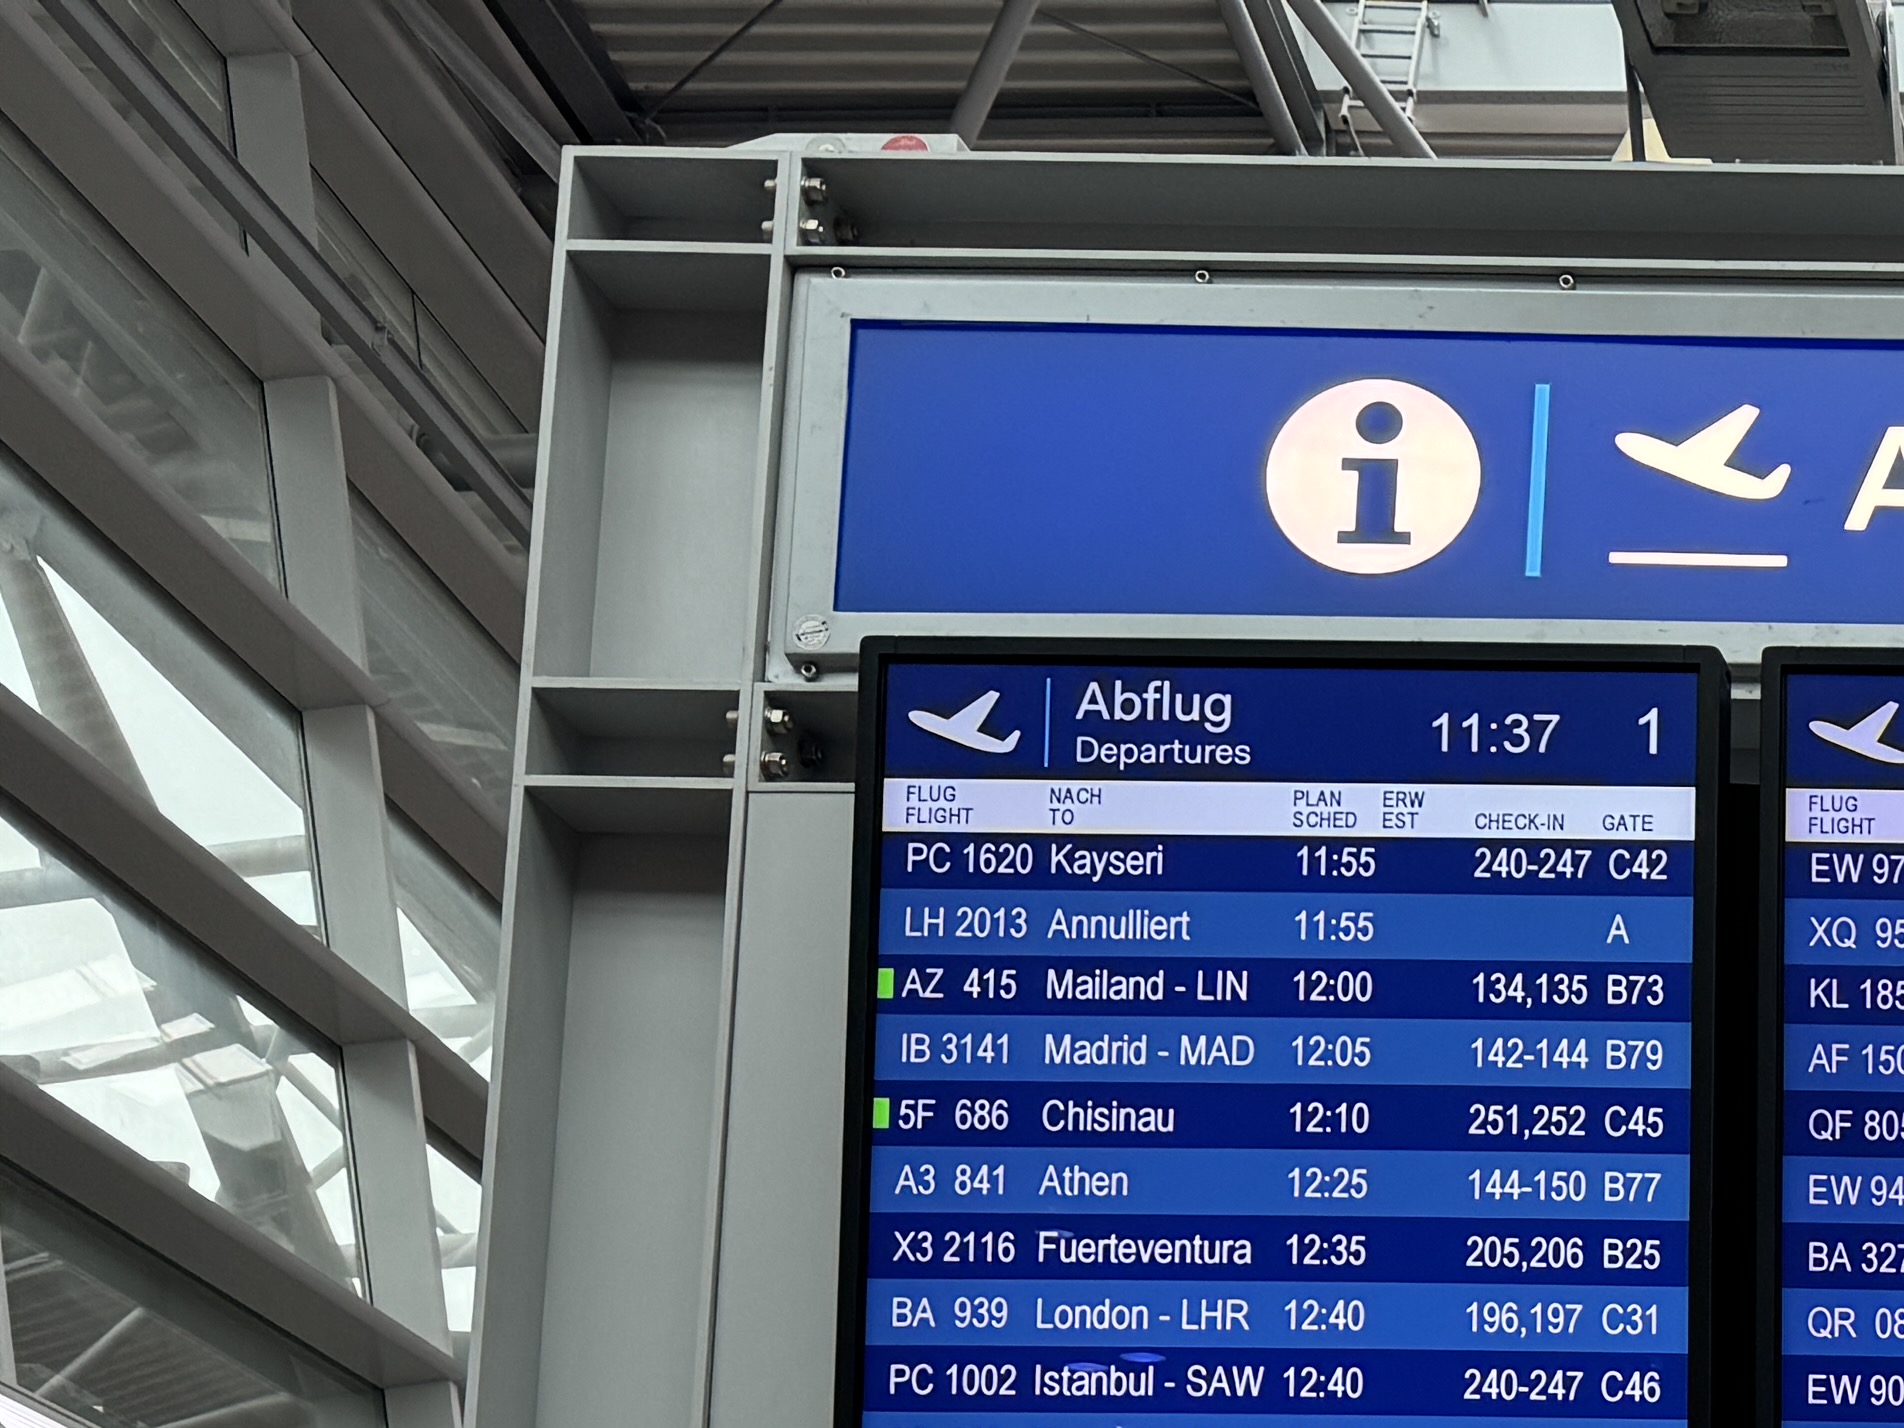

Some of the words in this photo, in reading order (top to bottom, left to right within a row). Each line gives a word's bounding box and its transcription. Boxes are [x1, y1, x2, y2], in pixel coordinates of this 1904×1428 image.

[1076, 680, 1231, 732] Abflug
[1433, 713, 1560, 753] 11:37
[1639, 708, 1657, 754] 1
[1077, 737, 1250, 770] Departures
[907, 785, 956, 802] FLUG
[1050, 787, 1101, 805] NACH
[1294, 790, 1341, 807] PLAN
[1383, 791, 1425, 808] ERW
[906, 807, 974, 824] FLIGHT
[1049, 808, 1074, 826] TO
[1293, 811, 1357, 828] SCHED
[1383, 812, 1419, 829] EST
[1475, 813, 1564, 831] CHECK-IN
[1603, 815, 1653, 832] GATE
[907, 842, 951, 873] PC
[963, 842, 1033, 875] 1620
[1050, 843, 1163, 883] Kayseri
[1296, 845, 1376, 877] 11:55
[1473, 847, 1592, 879] 240-247
[1608, 848, 1668, 880] C42
[1810, 978, 1849, 1009] KL
[898, 1099, 936, 1130] 5F
[955, 1098, 1009, 1131] 686
[1042, 1099, 1175, 1133] Chisinau
[1289, 1101, 1370, 1134] 12:10
[1468, 1103, 1586, 1140] 251,252
[1604, 1105, 1664, 1138] C45
